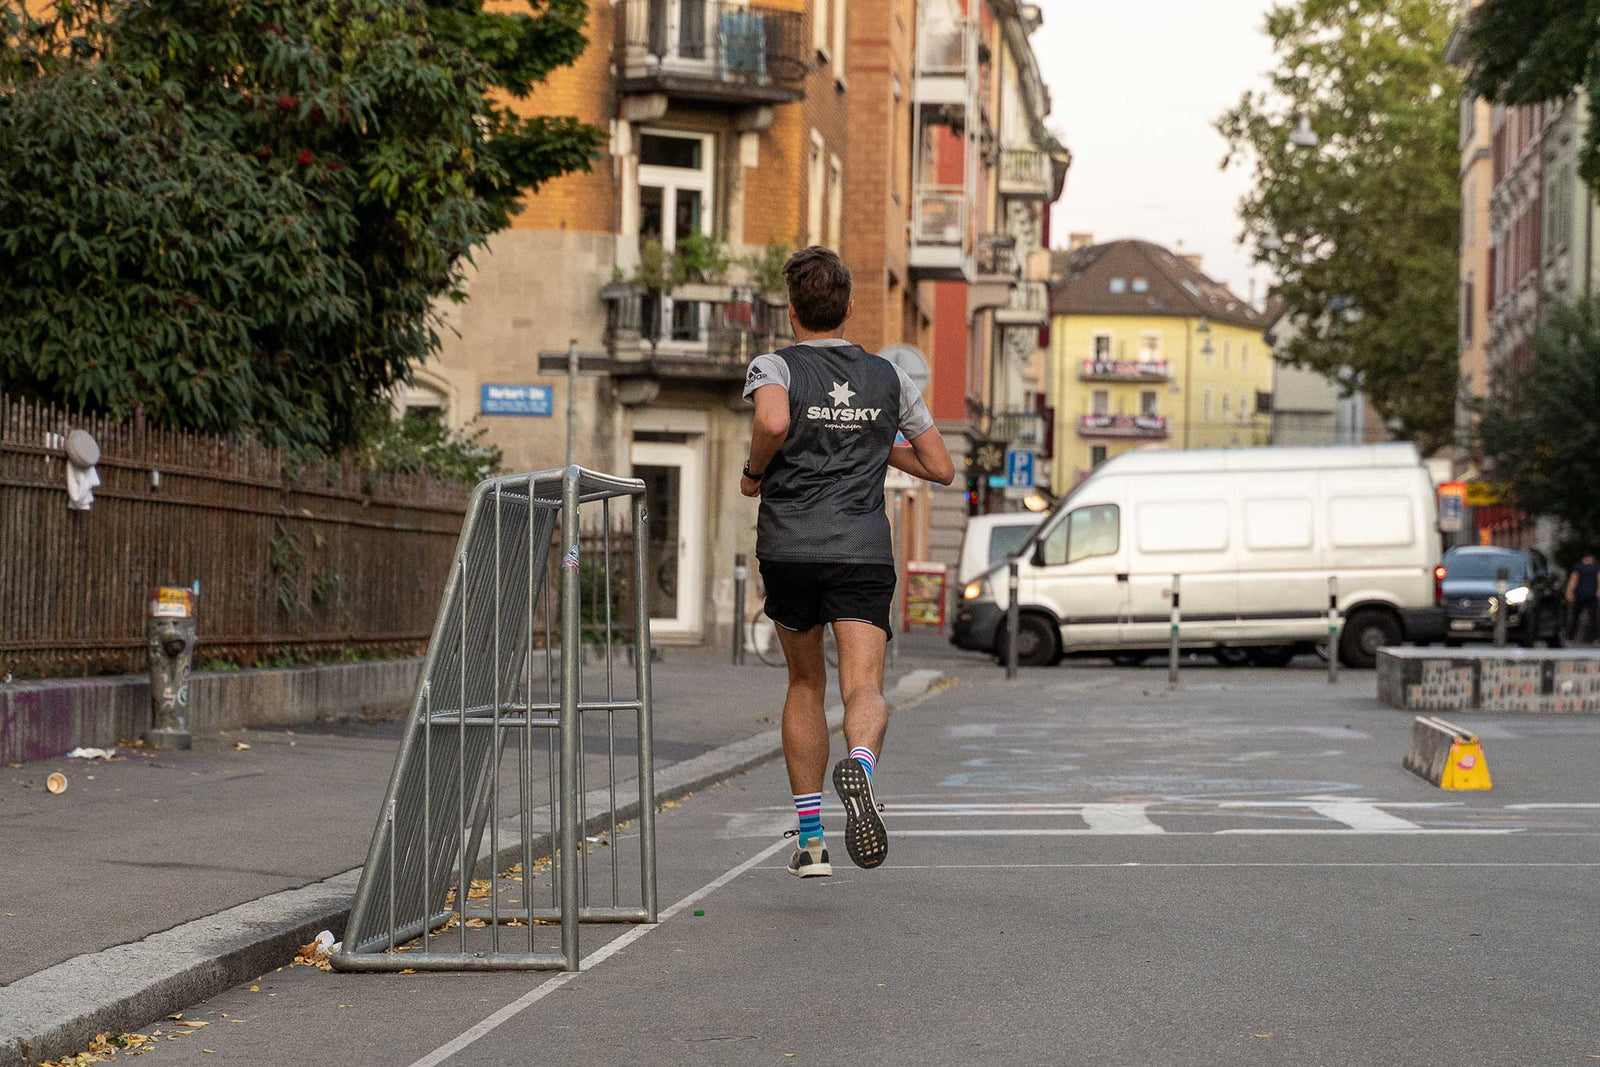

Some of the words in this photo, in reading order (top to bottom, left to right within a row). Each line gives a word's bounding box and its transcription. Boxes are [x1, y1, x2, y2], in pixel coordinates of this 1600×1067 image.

[807, 406, 881, 422] SAYSKY
[824, 423, 862, 431] copenhagen
[1015, 453, 1029, 471] P
